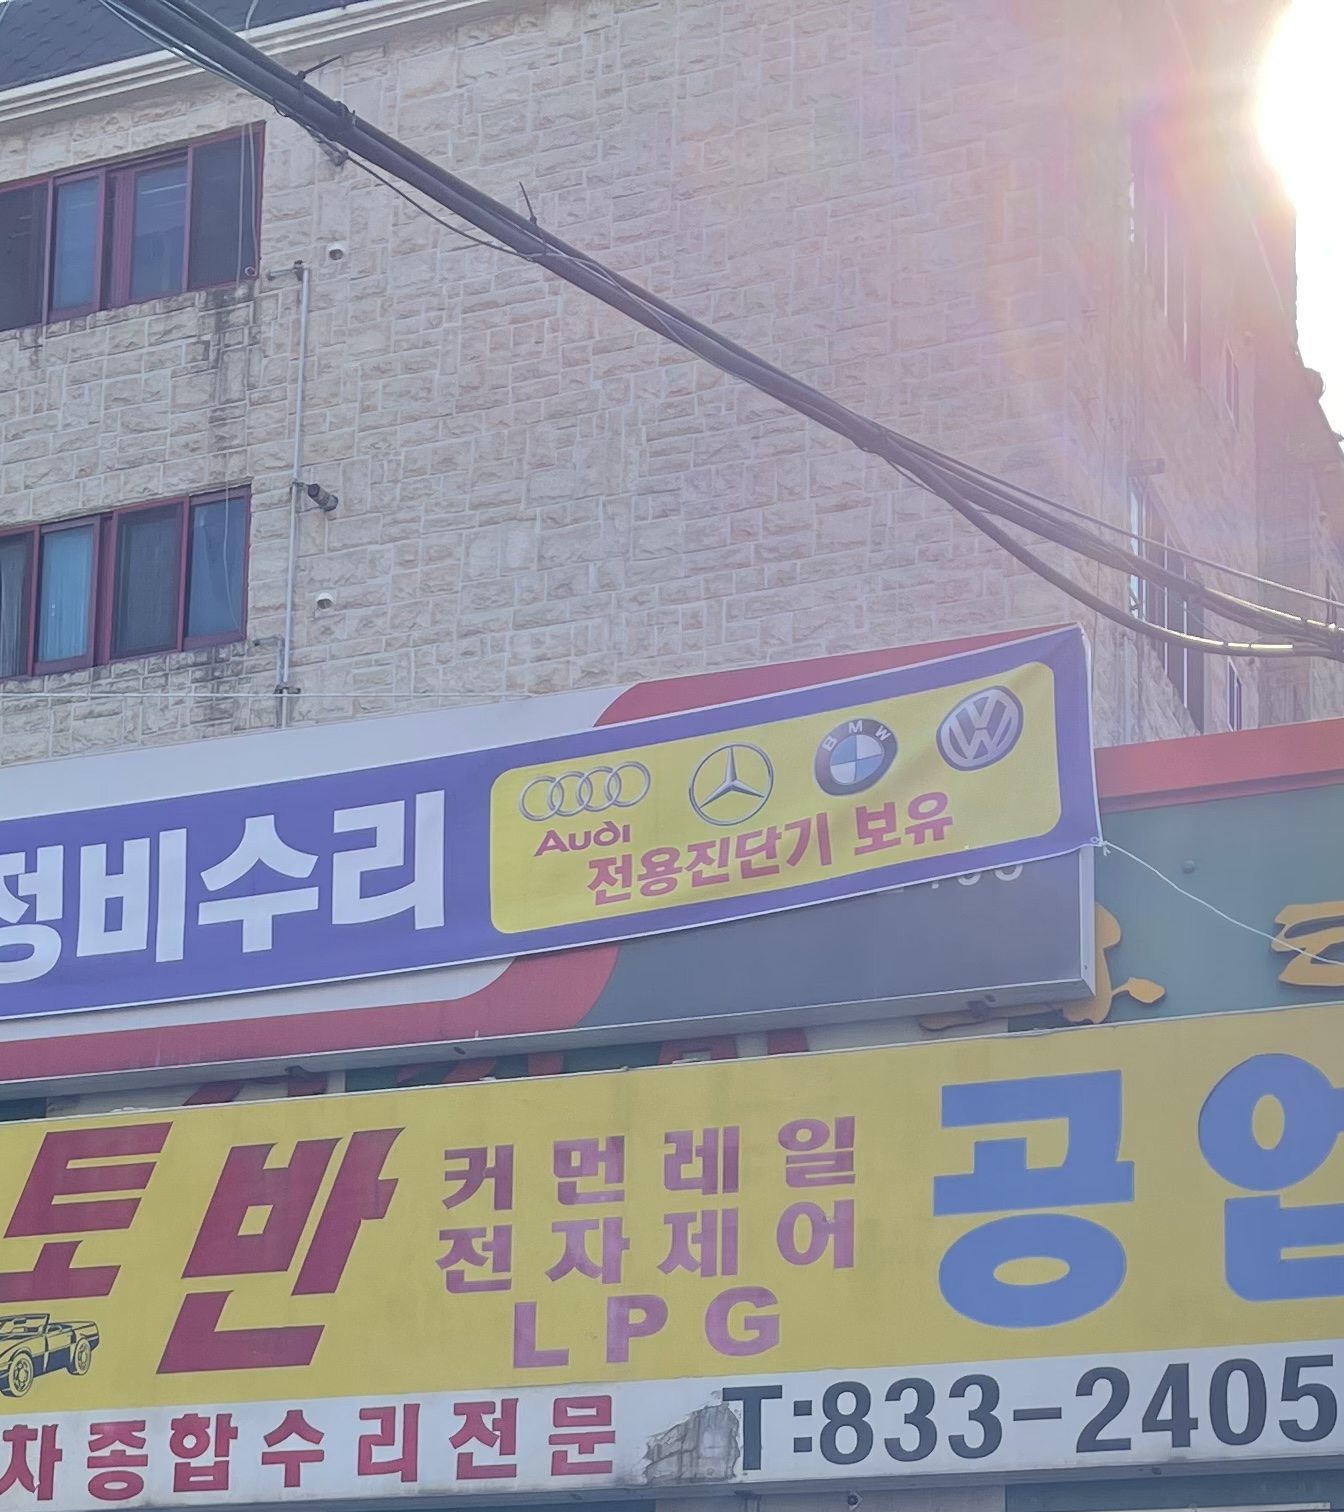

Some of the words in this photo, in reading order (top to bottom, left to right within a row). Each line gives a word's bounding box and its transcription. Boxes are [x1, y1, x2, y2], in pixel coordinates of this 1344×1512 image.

[533, 820, 632, 858] Audi
[585, 811, 833, 907] 전용진단기
[853, 790, 955, 858] 보유
[442, 1115, 857, 1212] 커먼레일
[435, 1199, 857, 1294] 전자제어
[512, 1286, 781, 1370] LPG
[721, 1353, 1339, 1472] T:833-2405
